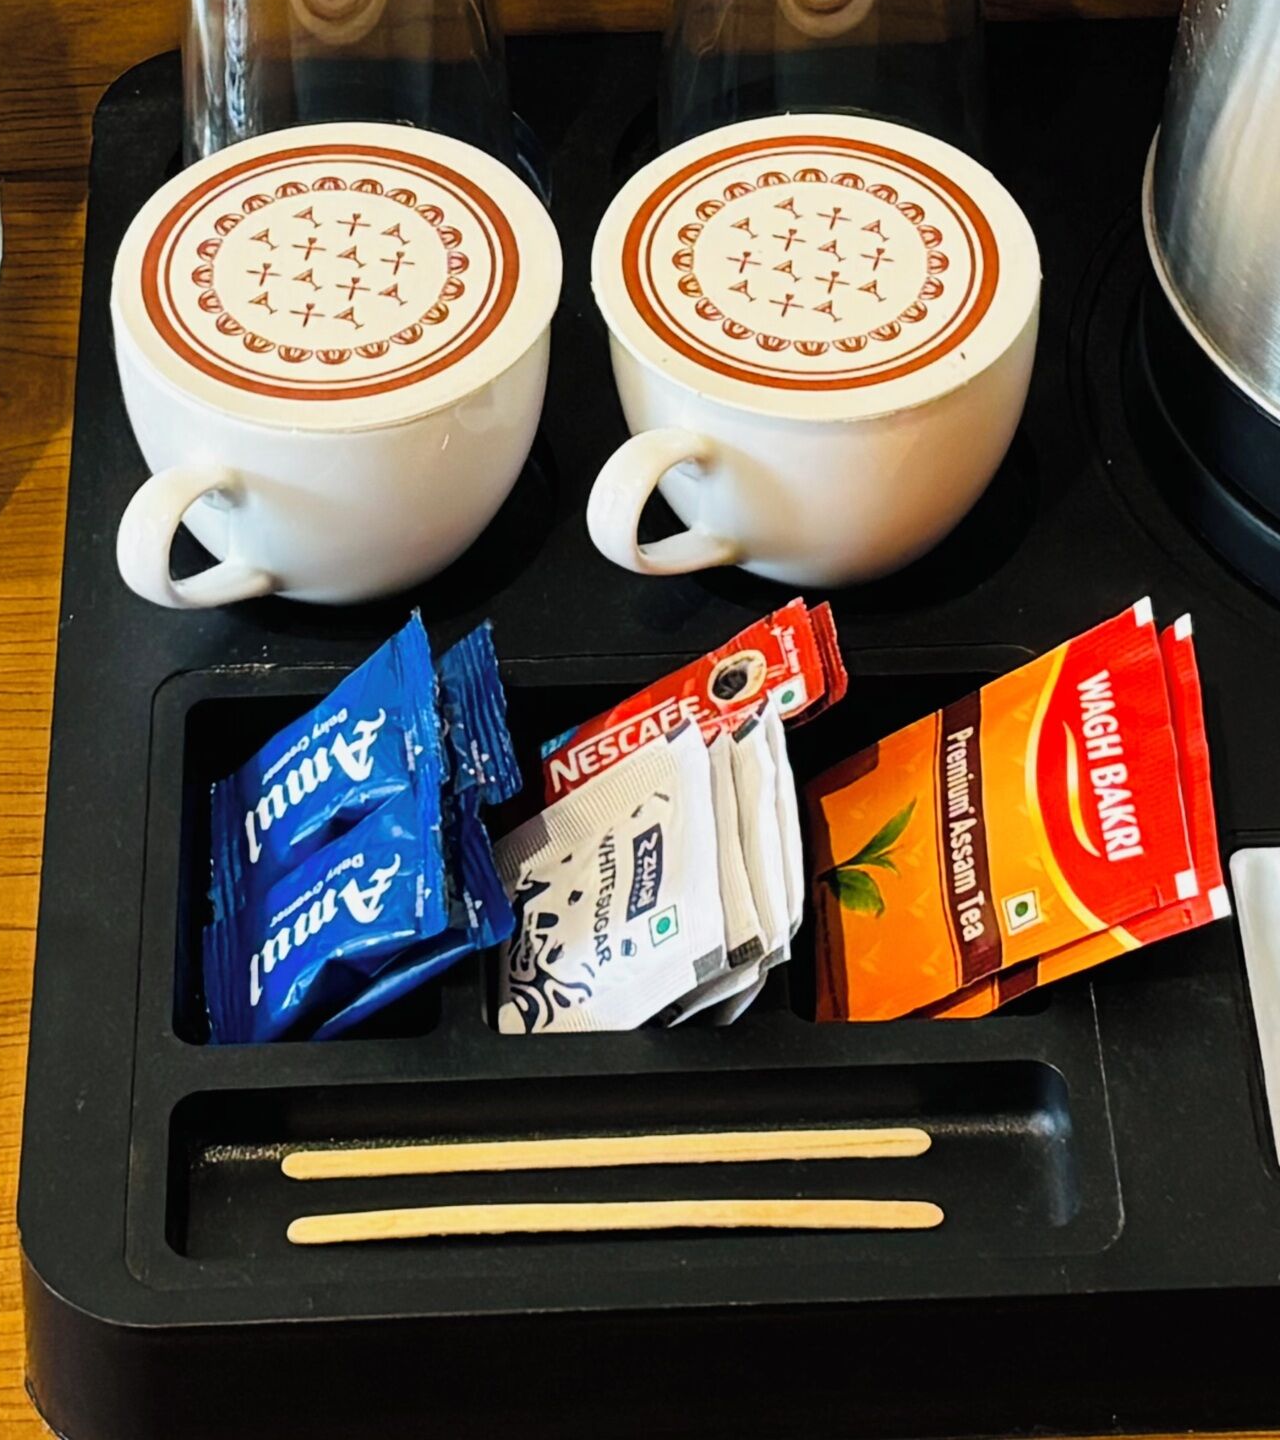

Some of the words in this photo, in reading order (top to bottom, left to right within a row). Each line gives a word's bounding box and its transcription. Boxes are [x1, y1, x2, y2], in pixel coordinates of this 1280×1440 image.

[1076, 669, 1124, 760] WAGH
[245, 707, 387, 864] Amul
[946, 726, 974, 818] Premium
[1088, 761, 1144, 863] BAKRI
[949, 817, 978, 895] Assam
[249, 852, 401, 1007] Amul
[954, 888, 985, 942] Tea
